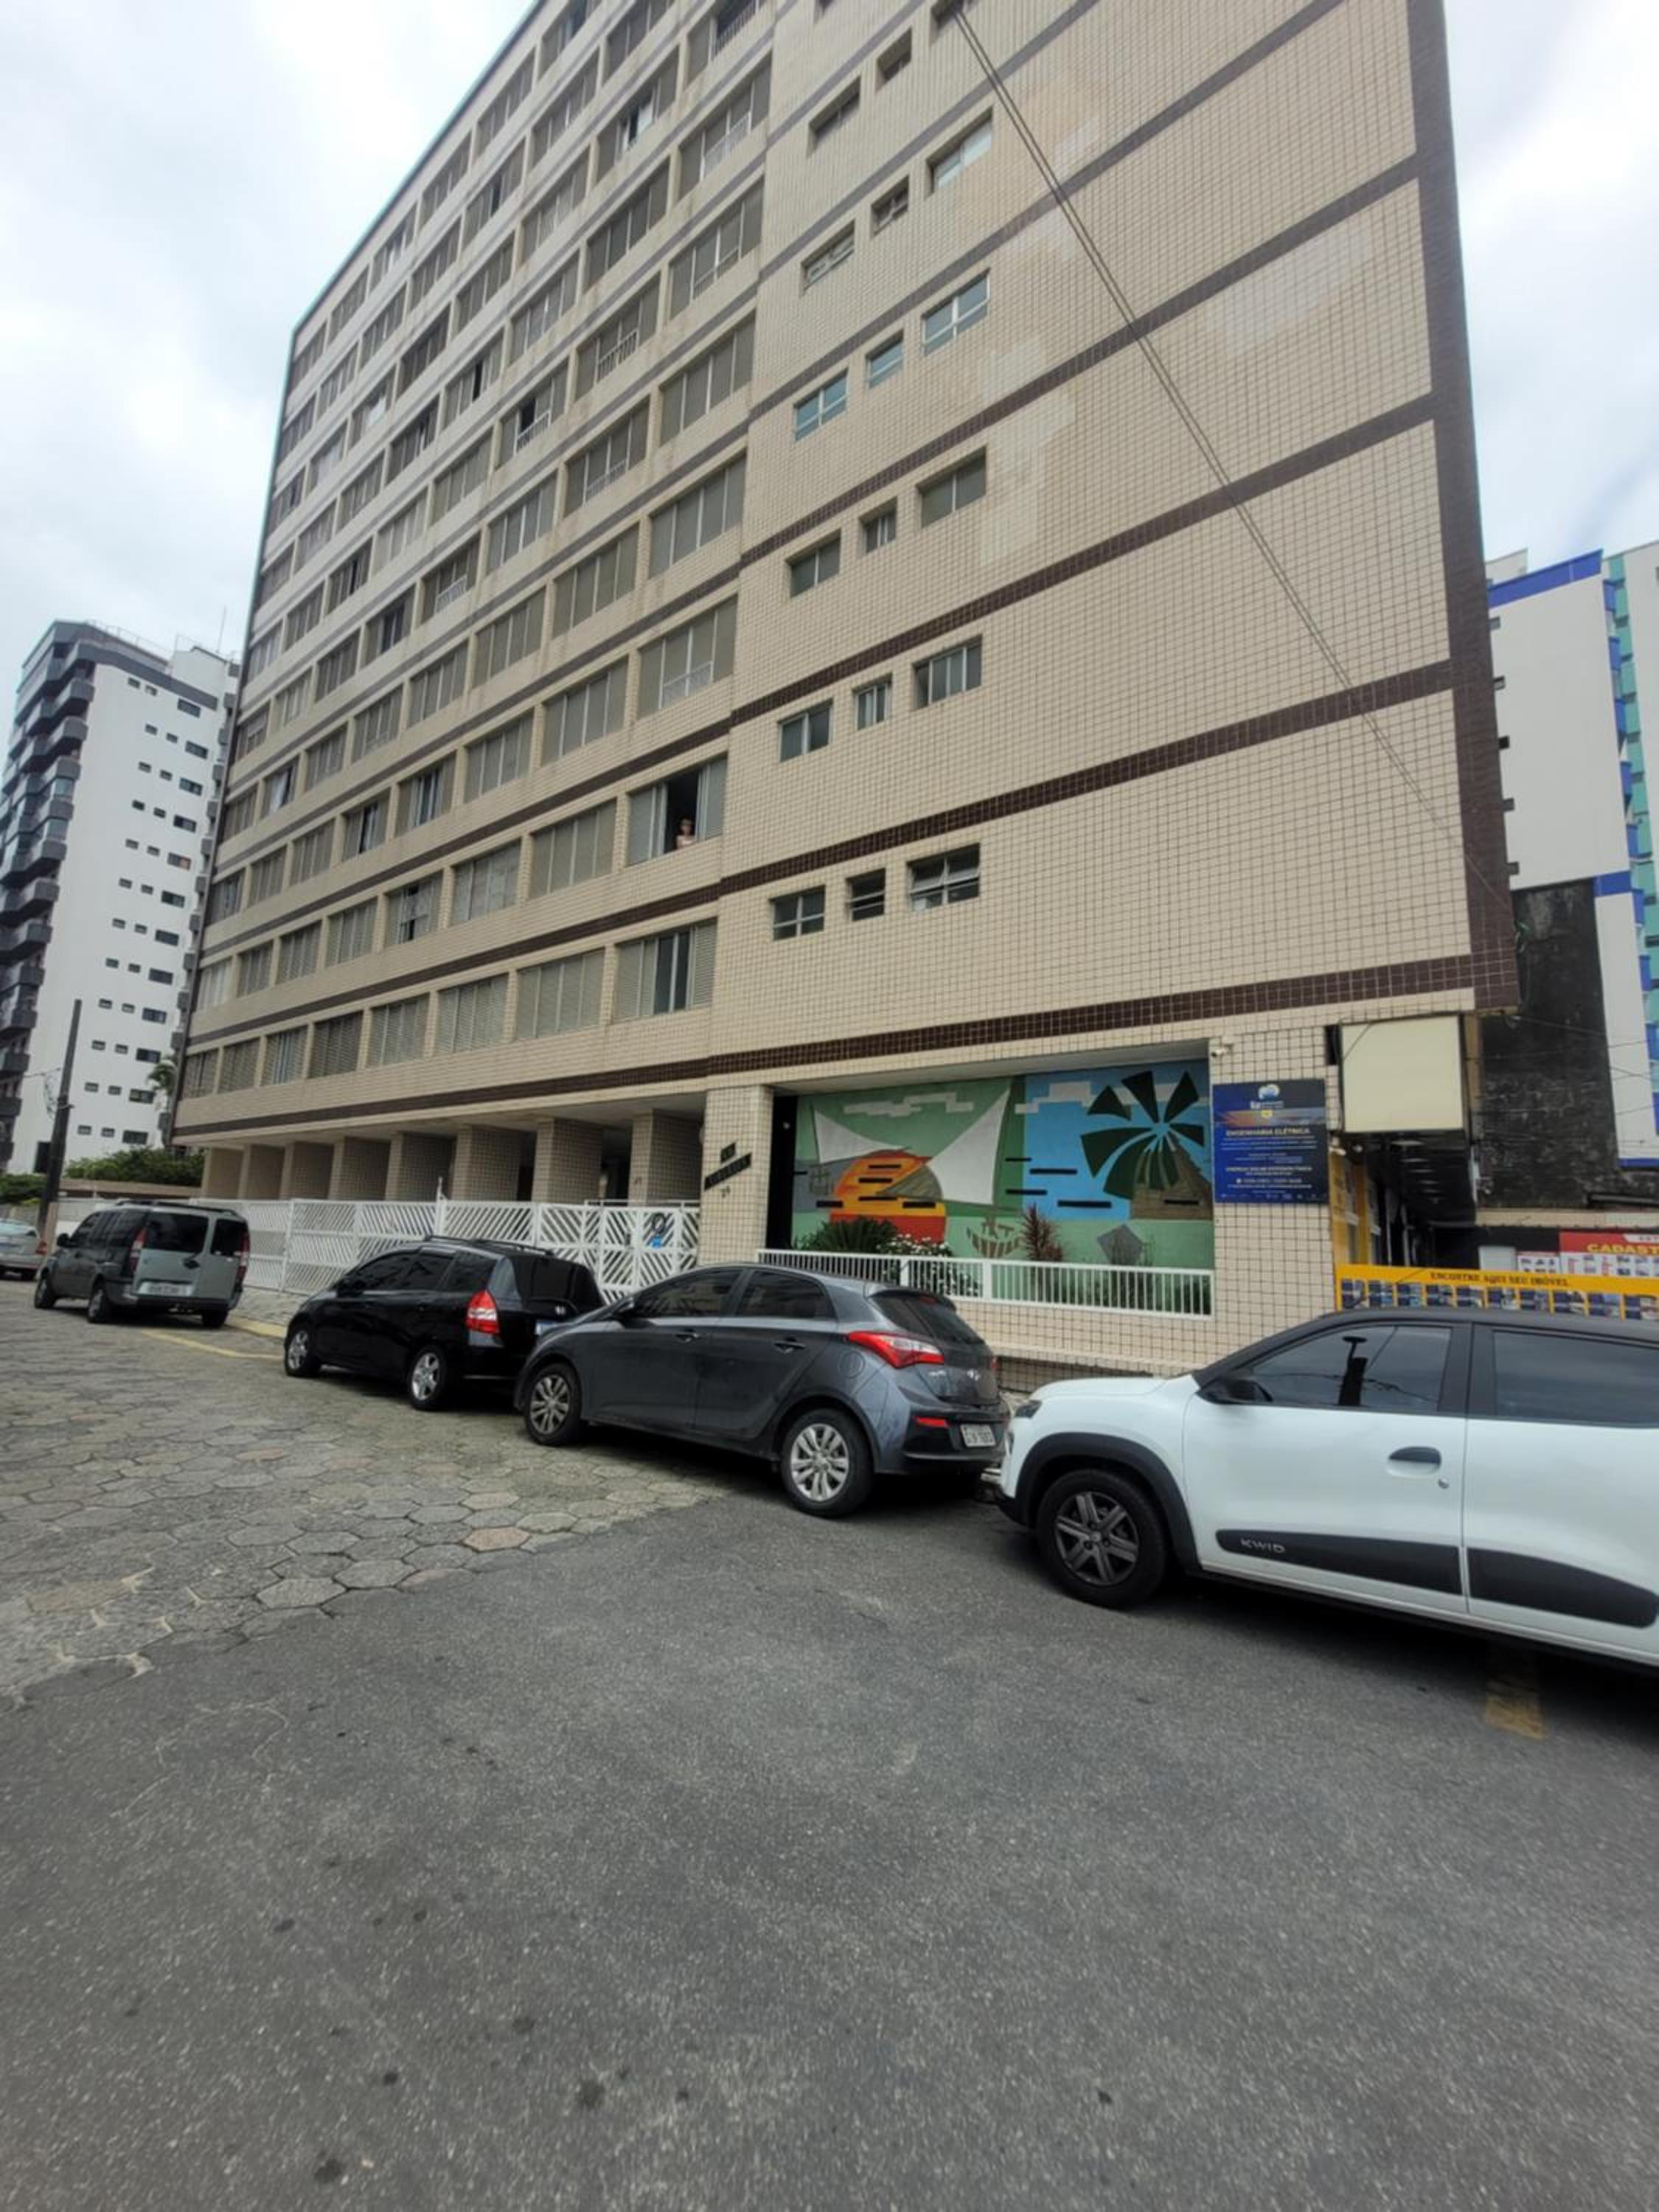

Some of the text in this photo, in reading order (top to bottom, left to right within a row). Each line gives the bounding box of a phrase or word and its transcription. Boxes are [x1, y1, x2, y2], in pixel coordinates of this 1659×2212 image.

[1430, 1272, 1480, 1281] ENCONTRE
[1484, 1274, 1506, 1284] AQUI
[1509, 1276, 1528, 1284] SEU
[1240, 1537, 1286, 1554] KWID
